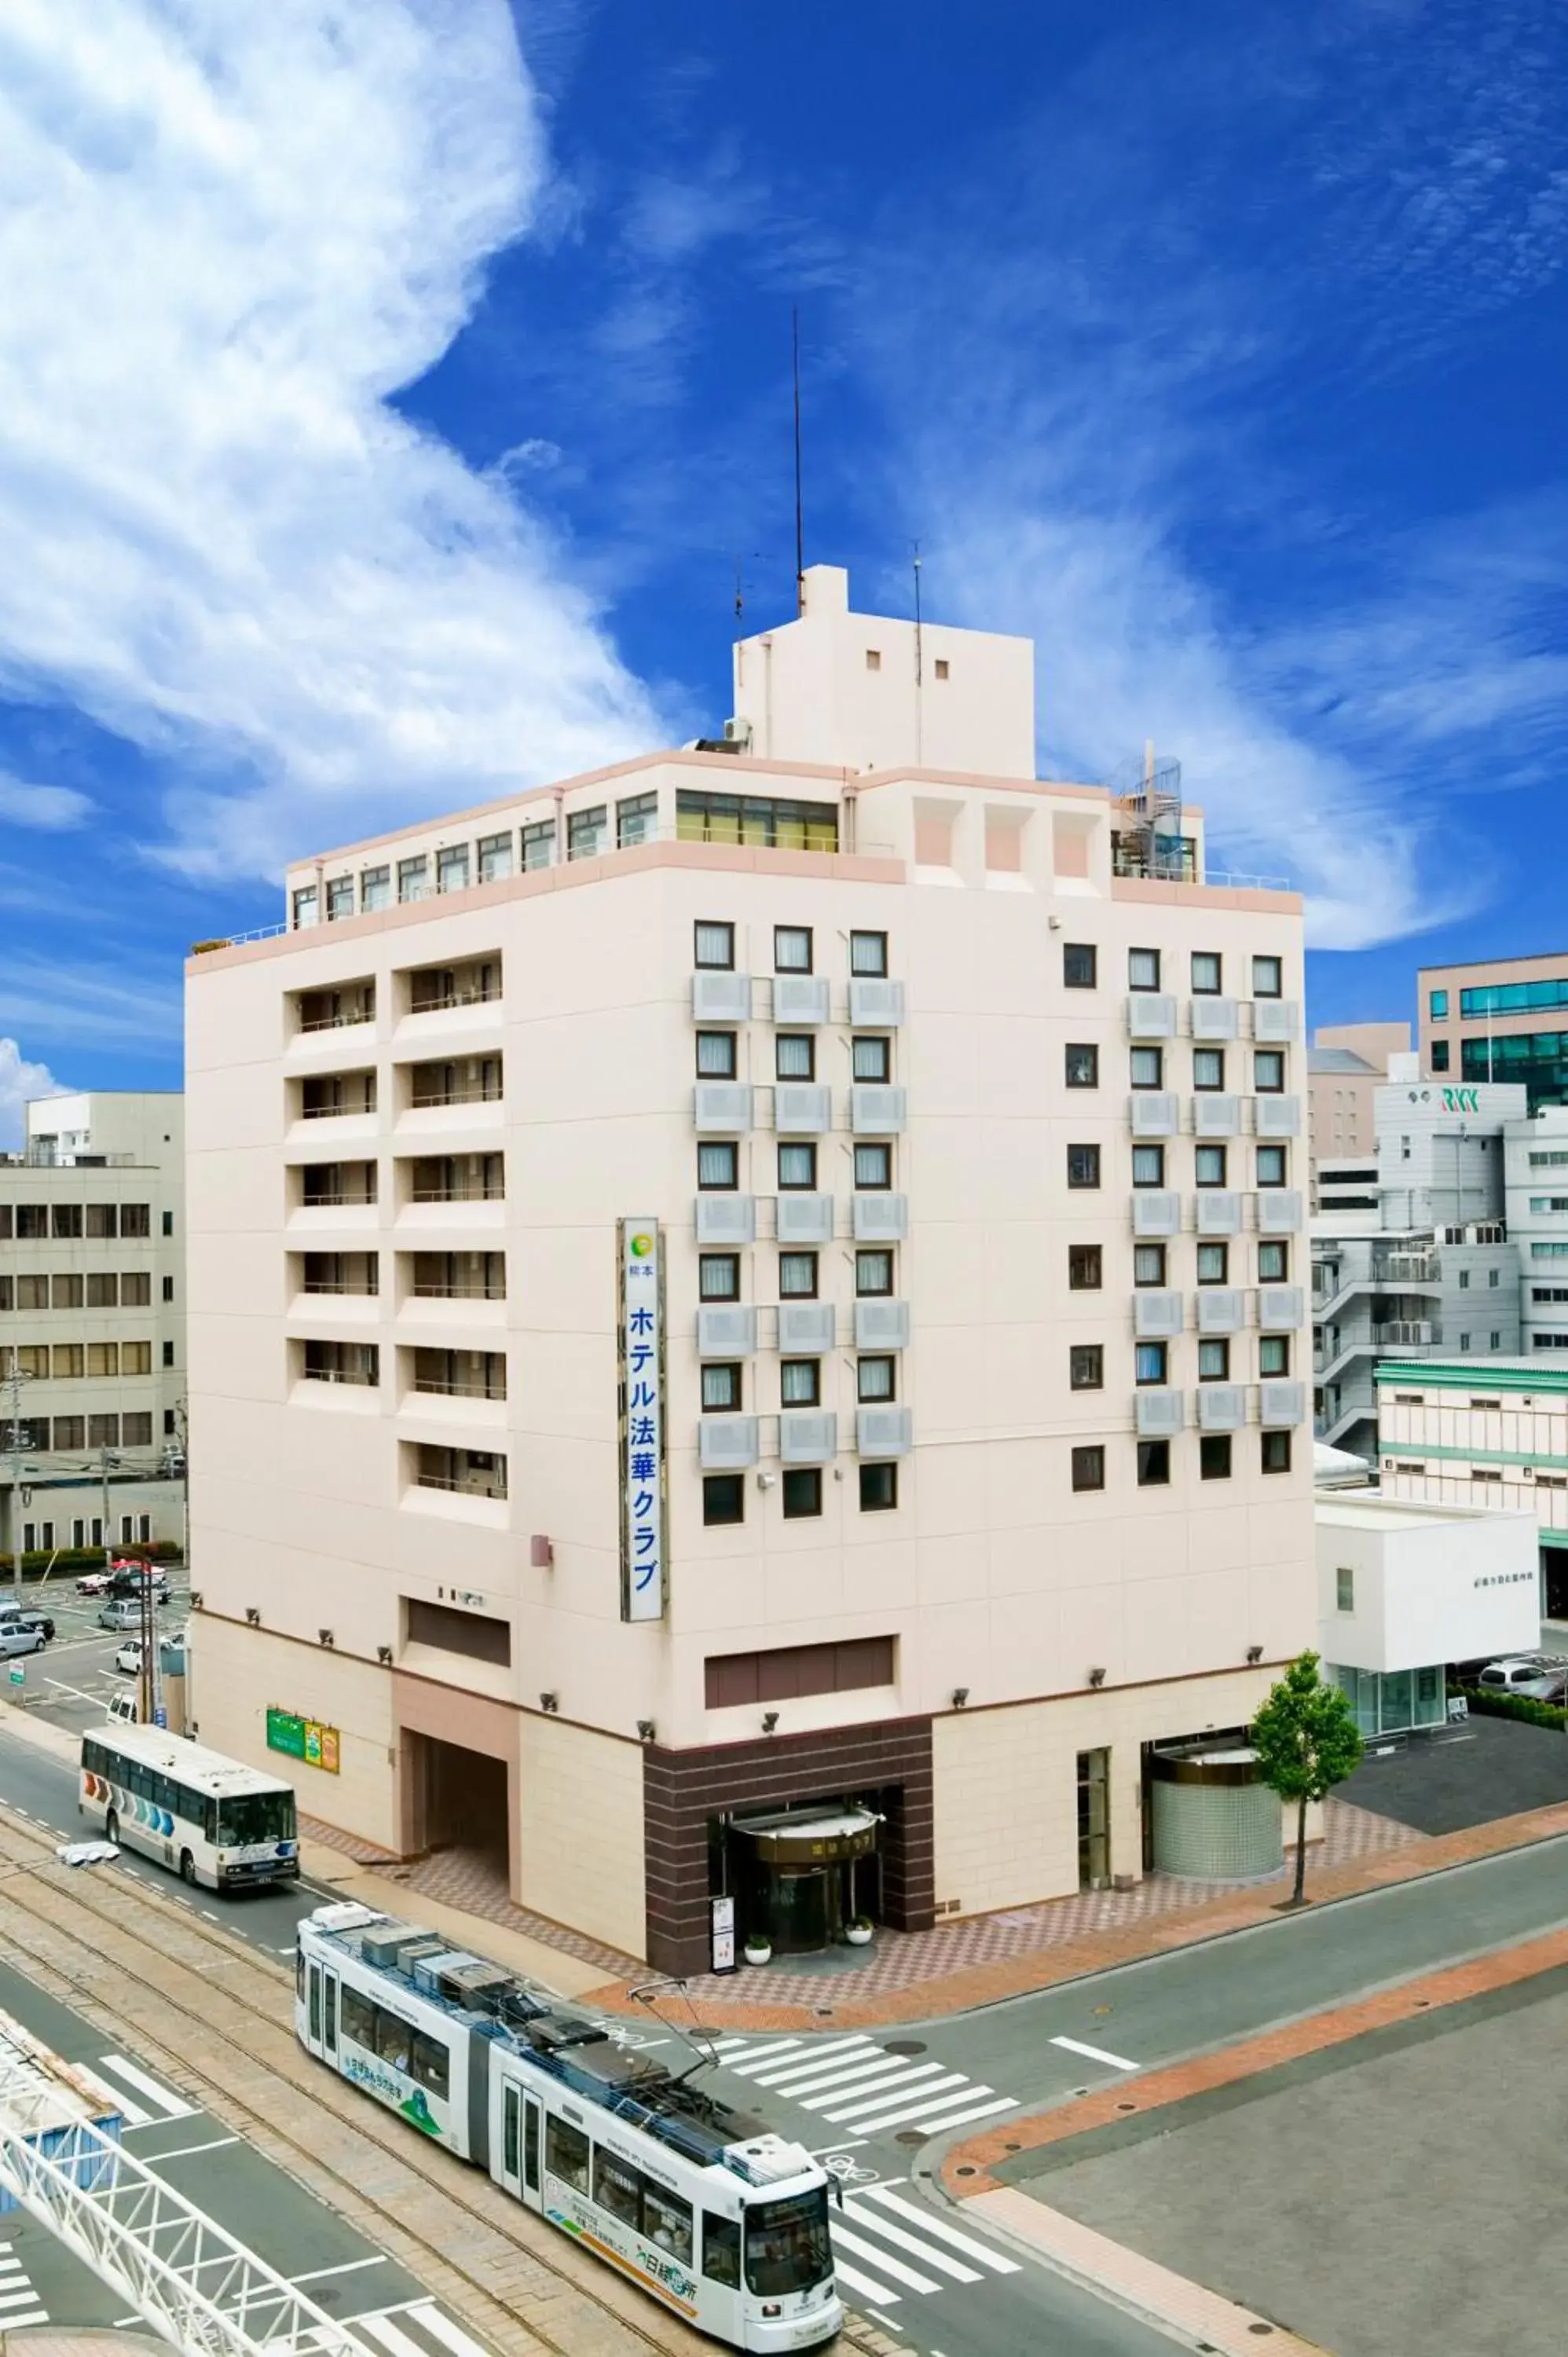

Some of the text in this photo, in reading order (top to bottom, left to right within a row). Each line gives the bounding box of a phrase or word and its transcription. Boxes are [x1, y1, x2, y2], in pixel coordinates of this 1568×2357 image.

[1442, 1088, 1478, 1113] RKK
[629, 1307, 658, 1592] ホテル法華クラブ
